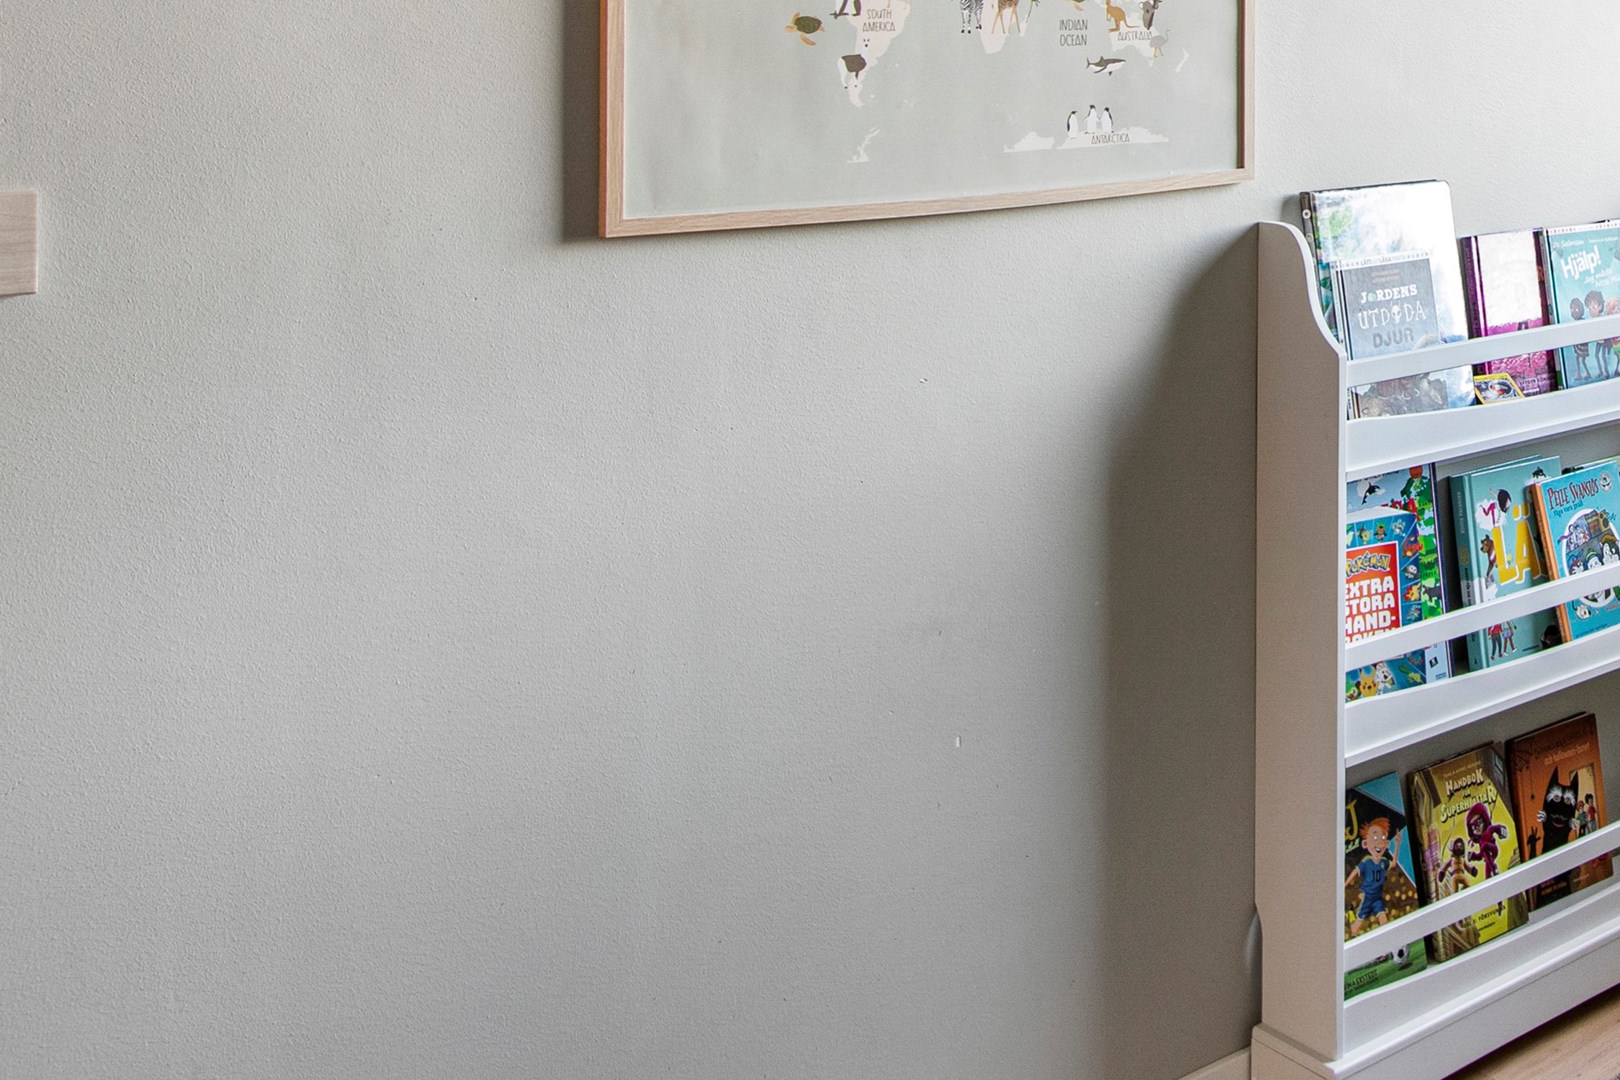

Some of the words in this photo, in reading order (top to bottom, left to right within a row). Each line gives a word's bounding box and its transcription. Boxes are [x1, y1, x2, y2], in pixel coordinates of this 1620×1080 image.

[867, 8, 892, 20] SOUTH
[862, 21, 896, 32] AMERICA
[1059, 18, 1088, 31] INDIAN
[1059, 34, 1088, 47] OCEAN
[1117, 30, 1153, 41] AUSTRALIA
[1091, 132, 1130, 144] ANTARCTICA
[1560, 245, 1602, 280] Hjälp!
[1373, 327, 1415, 348] DJUR
[1547, 487, 1570, 510] PELLE
[1445, 768, 1484, 797] HANDBOK
[1372, 870, 1381, 882] 10
